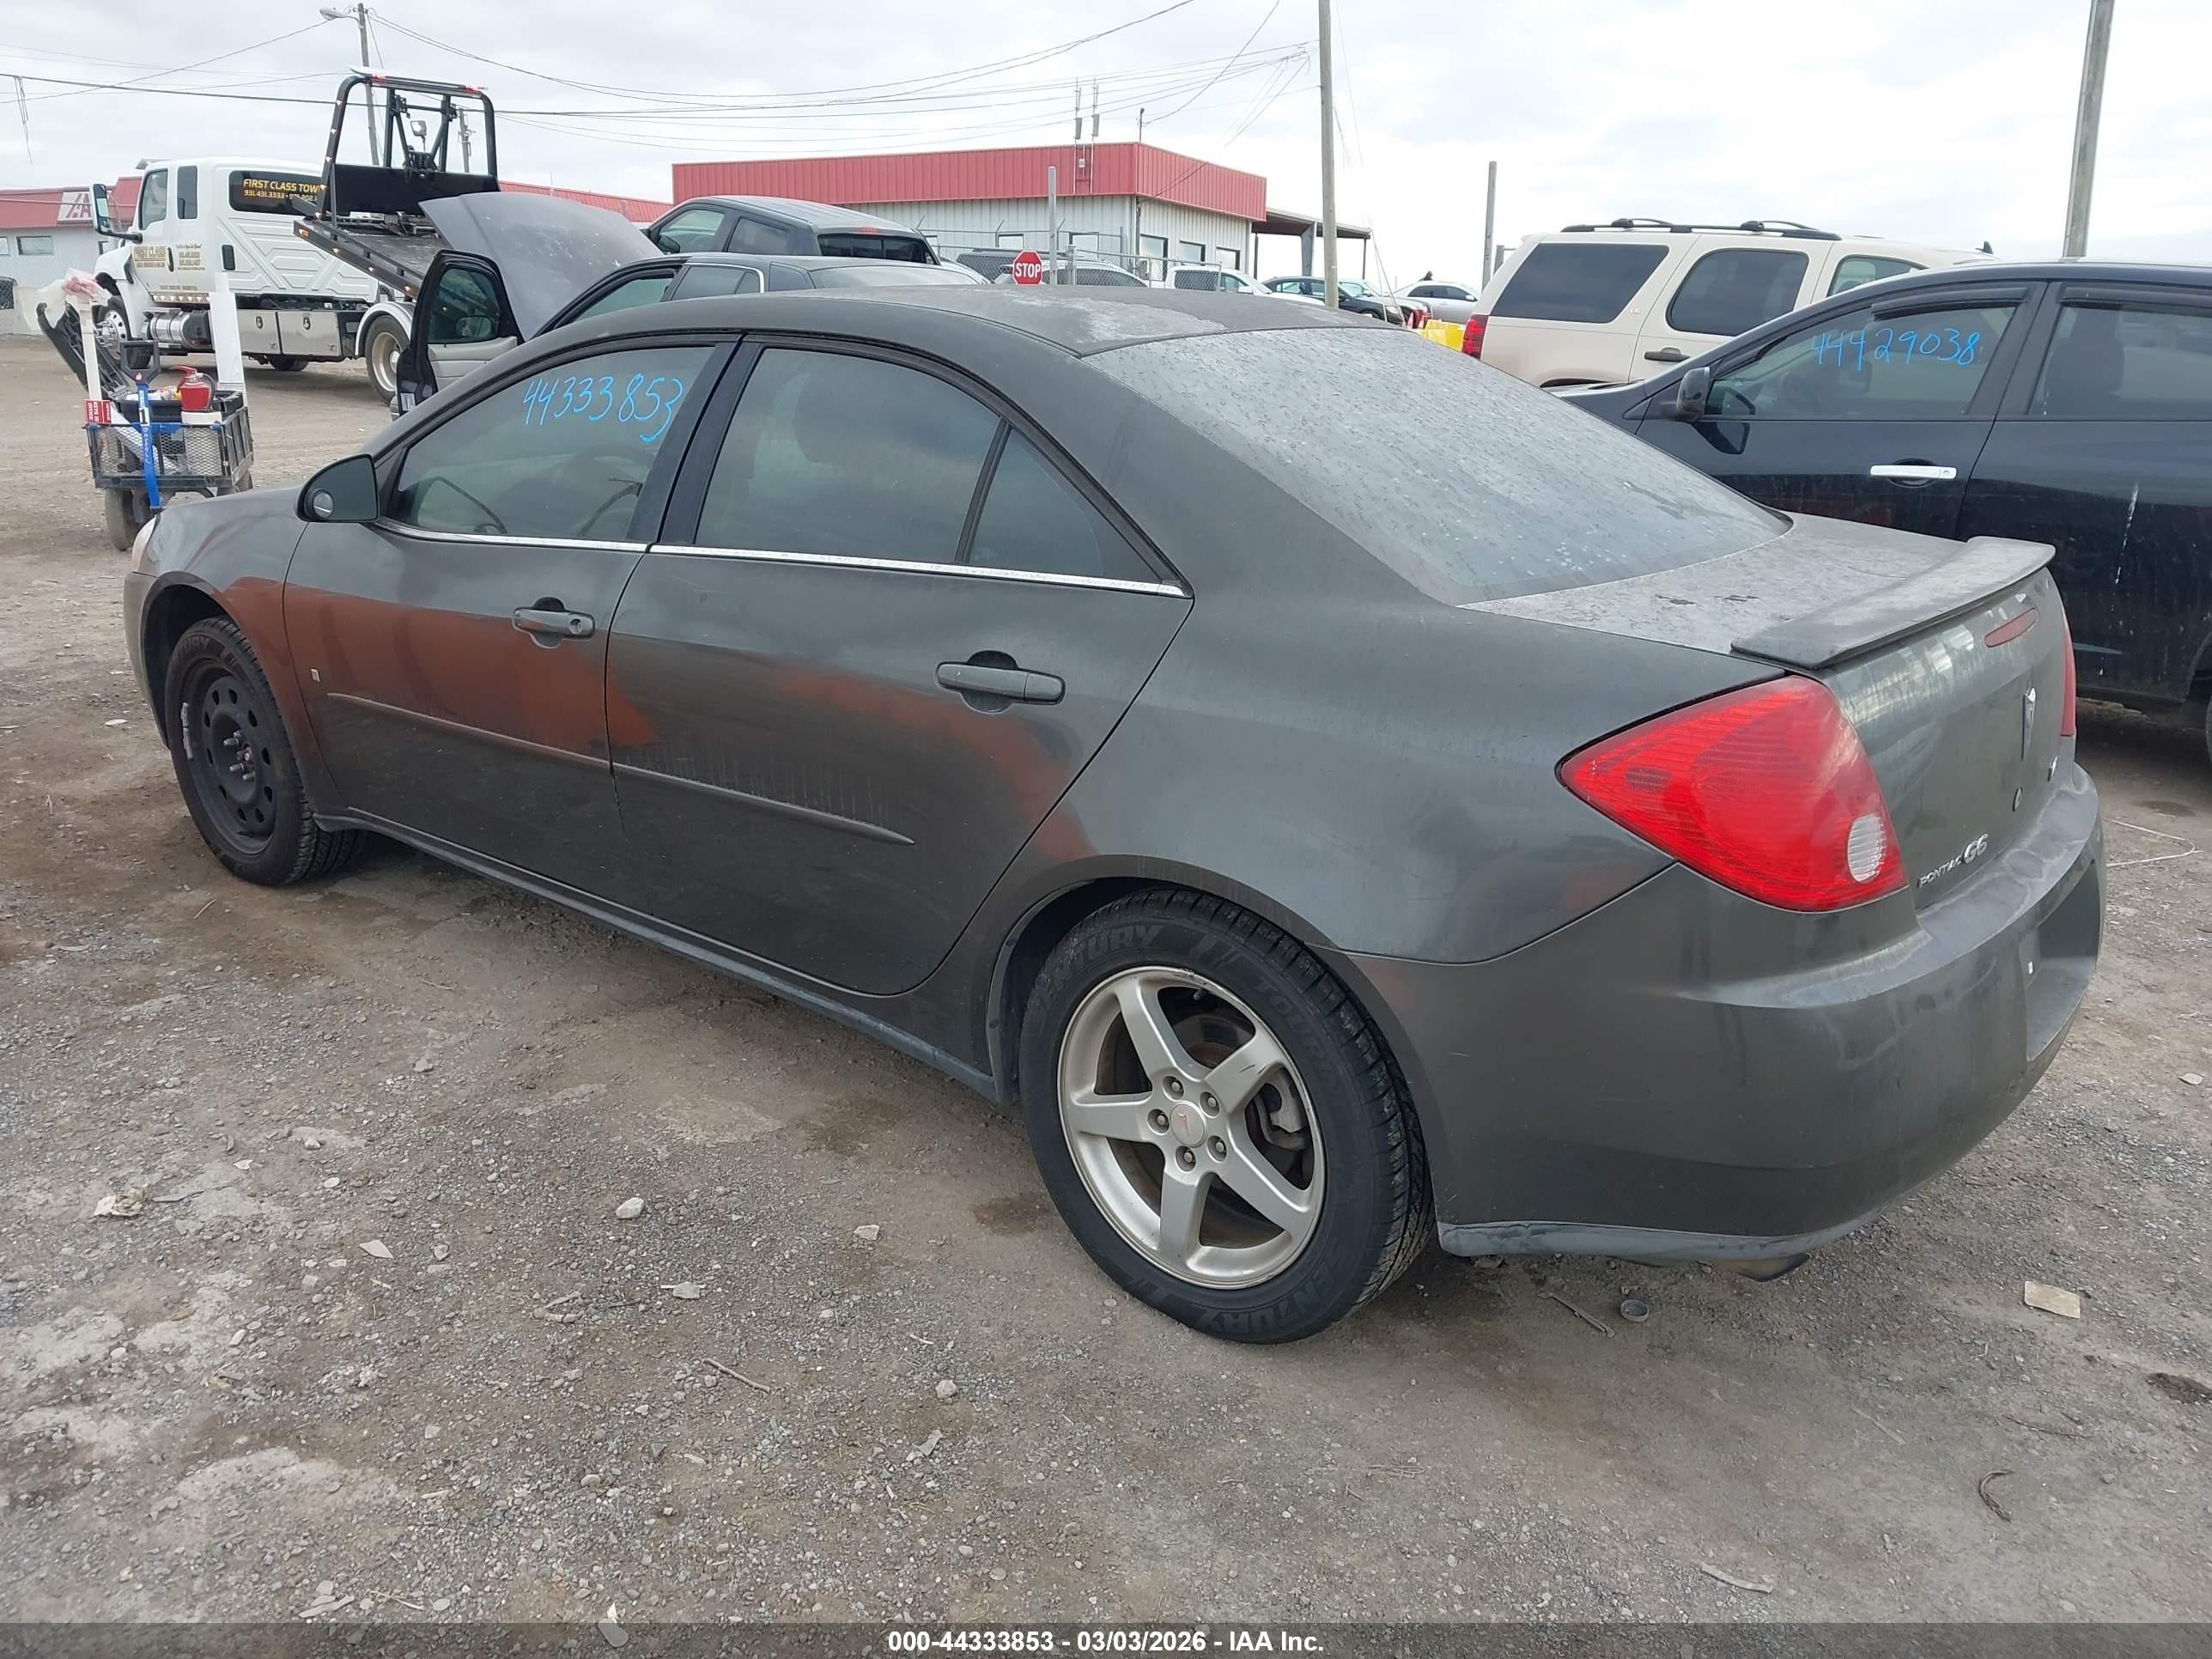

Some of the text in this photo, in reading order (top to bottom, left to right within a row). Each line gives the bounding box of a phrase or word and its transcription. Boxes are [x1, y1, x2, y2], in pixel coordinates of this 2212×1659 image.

[243, 178, 321, 193] FIRST CLASS TOW
[244, 189, 285, 198] 931.431.3333
[1015, 262, 1041, 278] STOP
[1811, 327, 1979, 371] 44429038
[522, 373, 684, 444] 44333853
[1917, 833, 1989, 888] PONTIAC G6
